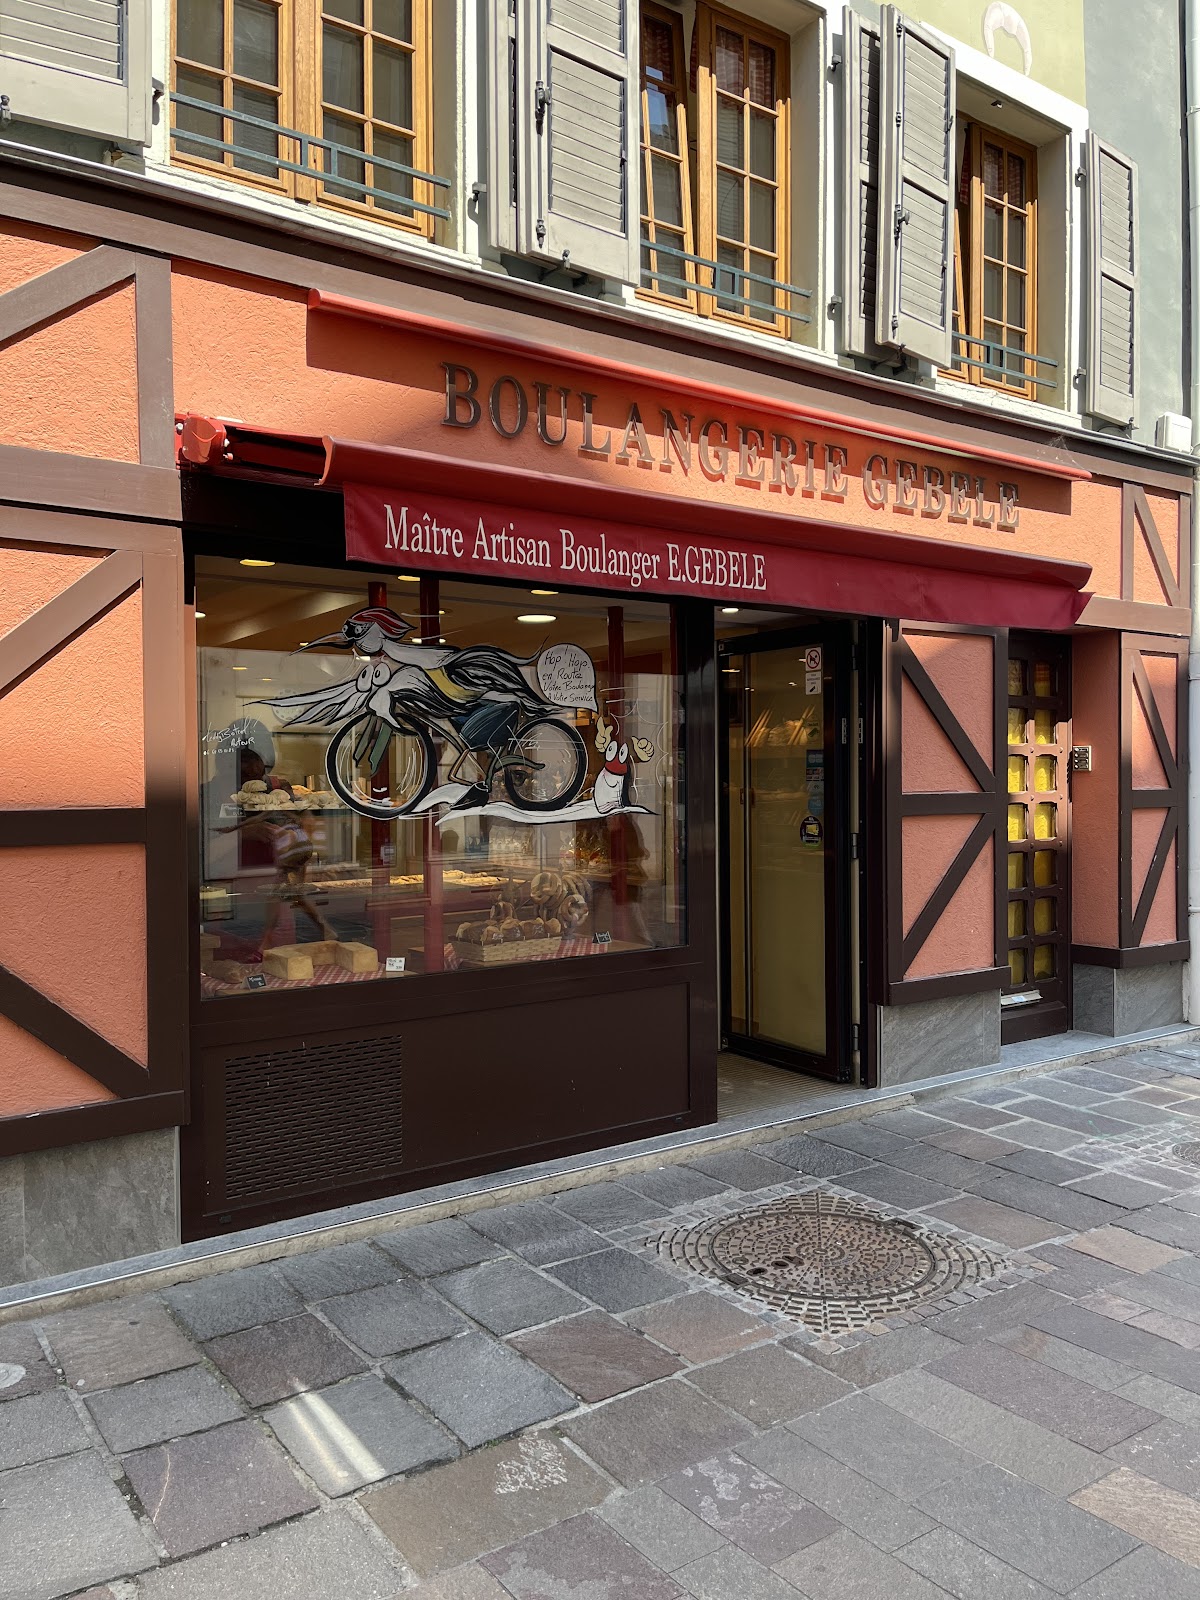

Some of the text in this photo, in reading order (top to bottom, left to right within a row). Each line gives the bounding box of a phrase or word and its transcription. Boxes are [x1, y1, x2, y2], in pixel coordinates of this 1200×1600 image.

[440, 361, 1020, 528] BOULANGERIE GEBELE
[383, 503, 767, 591] Maître Artisan Boulanger E.GEBELE
[557, 667, 583, 680] Route
